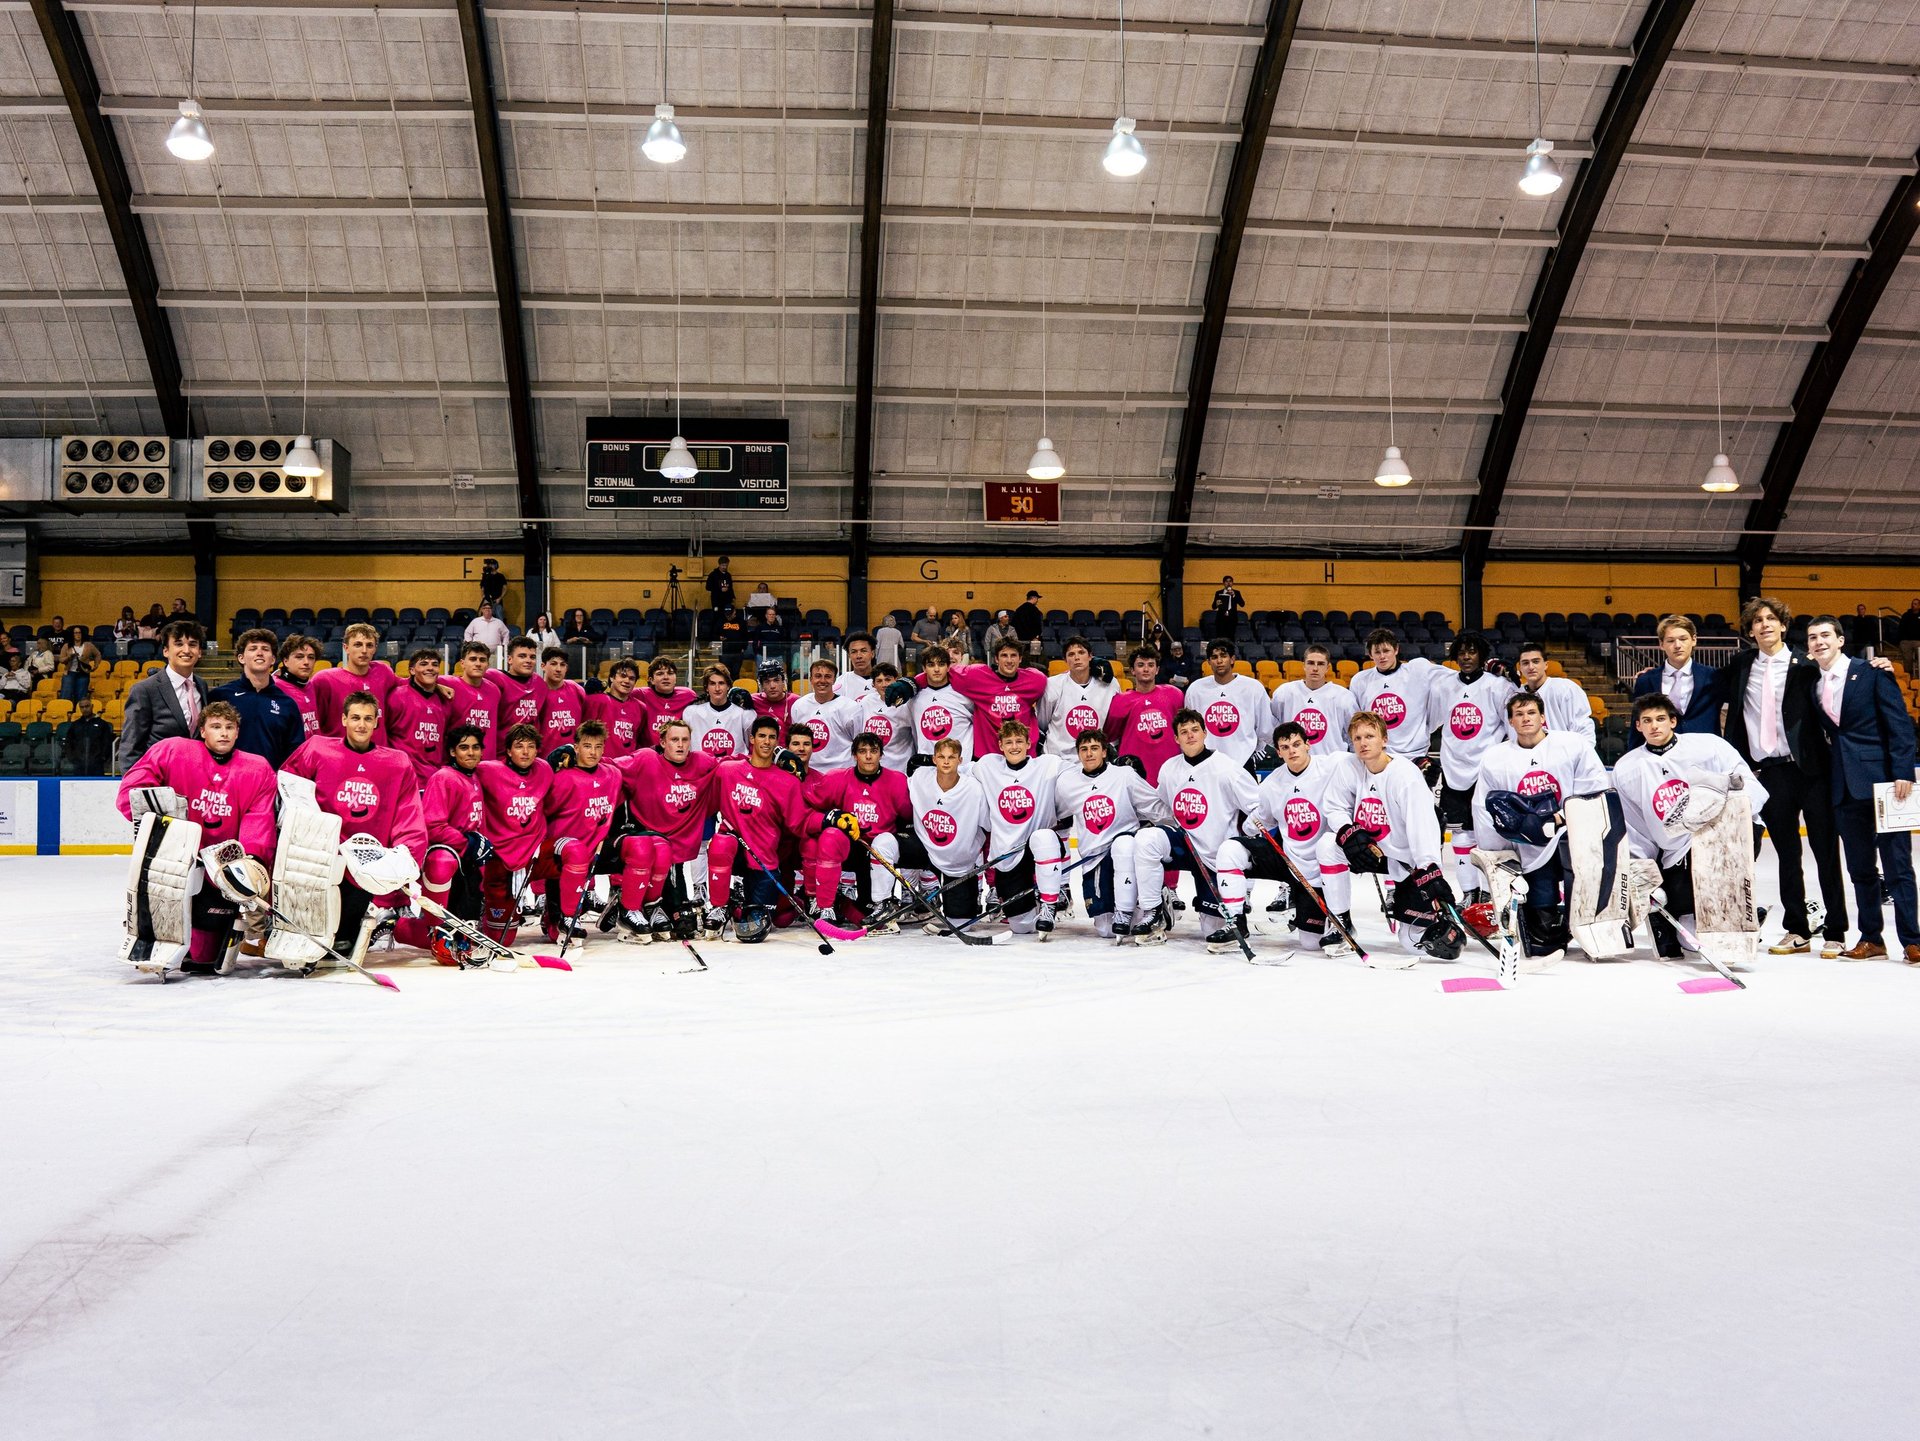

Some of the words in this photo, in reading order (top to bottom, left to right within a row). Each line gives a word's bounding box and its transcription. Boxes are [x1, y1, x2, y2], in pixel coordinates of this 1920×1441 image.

[594, 478, 618, 487] SETON
[619, 478, 635, 487] HALL
[739, 479, 780, 488] VISITOR
[1011, 496, 1033, 513] 50
[920, 559, 939, 581] G
[1324, 562, 1334, 583] H
[12, 574, 24, 596] E
[520, 700, 536, 708] PUCK
[994, 695, 1017, 704] PUCK
[1376, 696, 1398, 706] PUCK
[991, 702, 1020, 712] CACER
[1211, 705, 1234, 714] PUCK
[1373, 704, 1405, 716] CACER
[1455, 706, 1477, 716] PUCK
[470, 709, 488, 719] PUCK
[516, 708, 538, 718] CACER
[552, 710, 572, 720] PUCK
[924, 708, 945, 718] PUCK
[1072, 709, 1094, 718] PUCK
[1140, 712, 1163, 722] PUCK
[1206, 713, 1238, 724] CACER
[1300, 712, 1322, 722] PUCK
[466, 718, 490, 729] CACER
[548, 718, 576, 729] CACER
[868, 718, 887, 728] PUCK
[921, 716, 950, 728] CACER
[1068, 718, 1097, 728] CACER
[1137, 718, 1168, 732] CACER
[1451, 715, 1482, 725] CACER
[419, 722, 438, 733] PUCK
[865, 727, 890, 738] CACER
[414, 731, 440, 742] CACER
[707, 732, 728, 740] PUCK
[703, 739, 732, 749] CACER
[1523, 774, 1550, 788] PUCK
[344, 780, 374, 795] PUCK
[670, 784, 692, 794] PUCK
[735, 782, 758, 798] PUCK
[1660, 782, 1690, 800] PUCK
[201, 788, 229, 804] PUCK
[336, 791, 378, 806] CACER
[665, 791, 697, 804] CACER
[730, 790, 762, 807] CACER
[1003, 790, 1027, 800] PUCK
[1180, 792, 1203, 804] PUCK
[512, 797, 536, 807] PUCK
[588, 796, 609, 807] PUCK
[1000, 798, 1033, 809] CACER
[1086, 798, 1110, 810] PUCK
[191, 798, 232, 817] CACER
[584, 804, 613, 818] CACER
[853, 802, 876, 814] PUCK
[1084, 804, 1113, 820] CACER
[1175, 801, 1206, 815] CACER
[1286, 802, 1310, 813] PUCK
[1362, 802, 1388, 815] PUCK
[928, 812, 950, 824] PUCK
[1358, 810, 1390, 826] CACER
[923, 820, 955, 834] CACER
